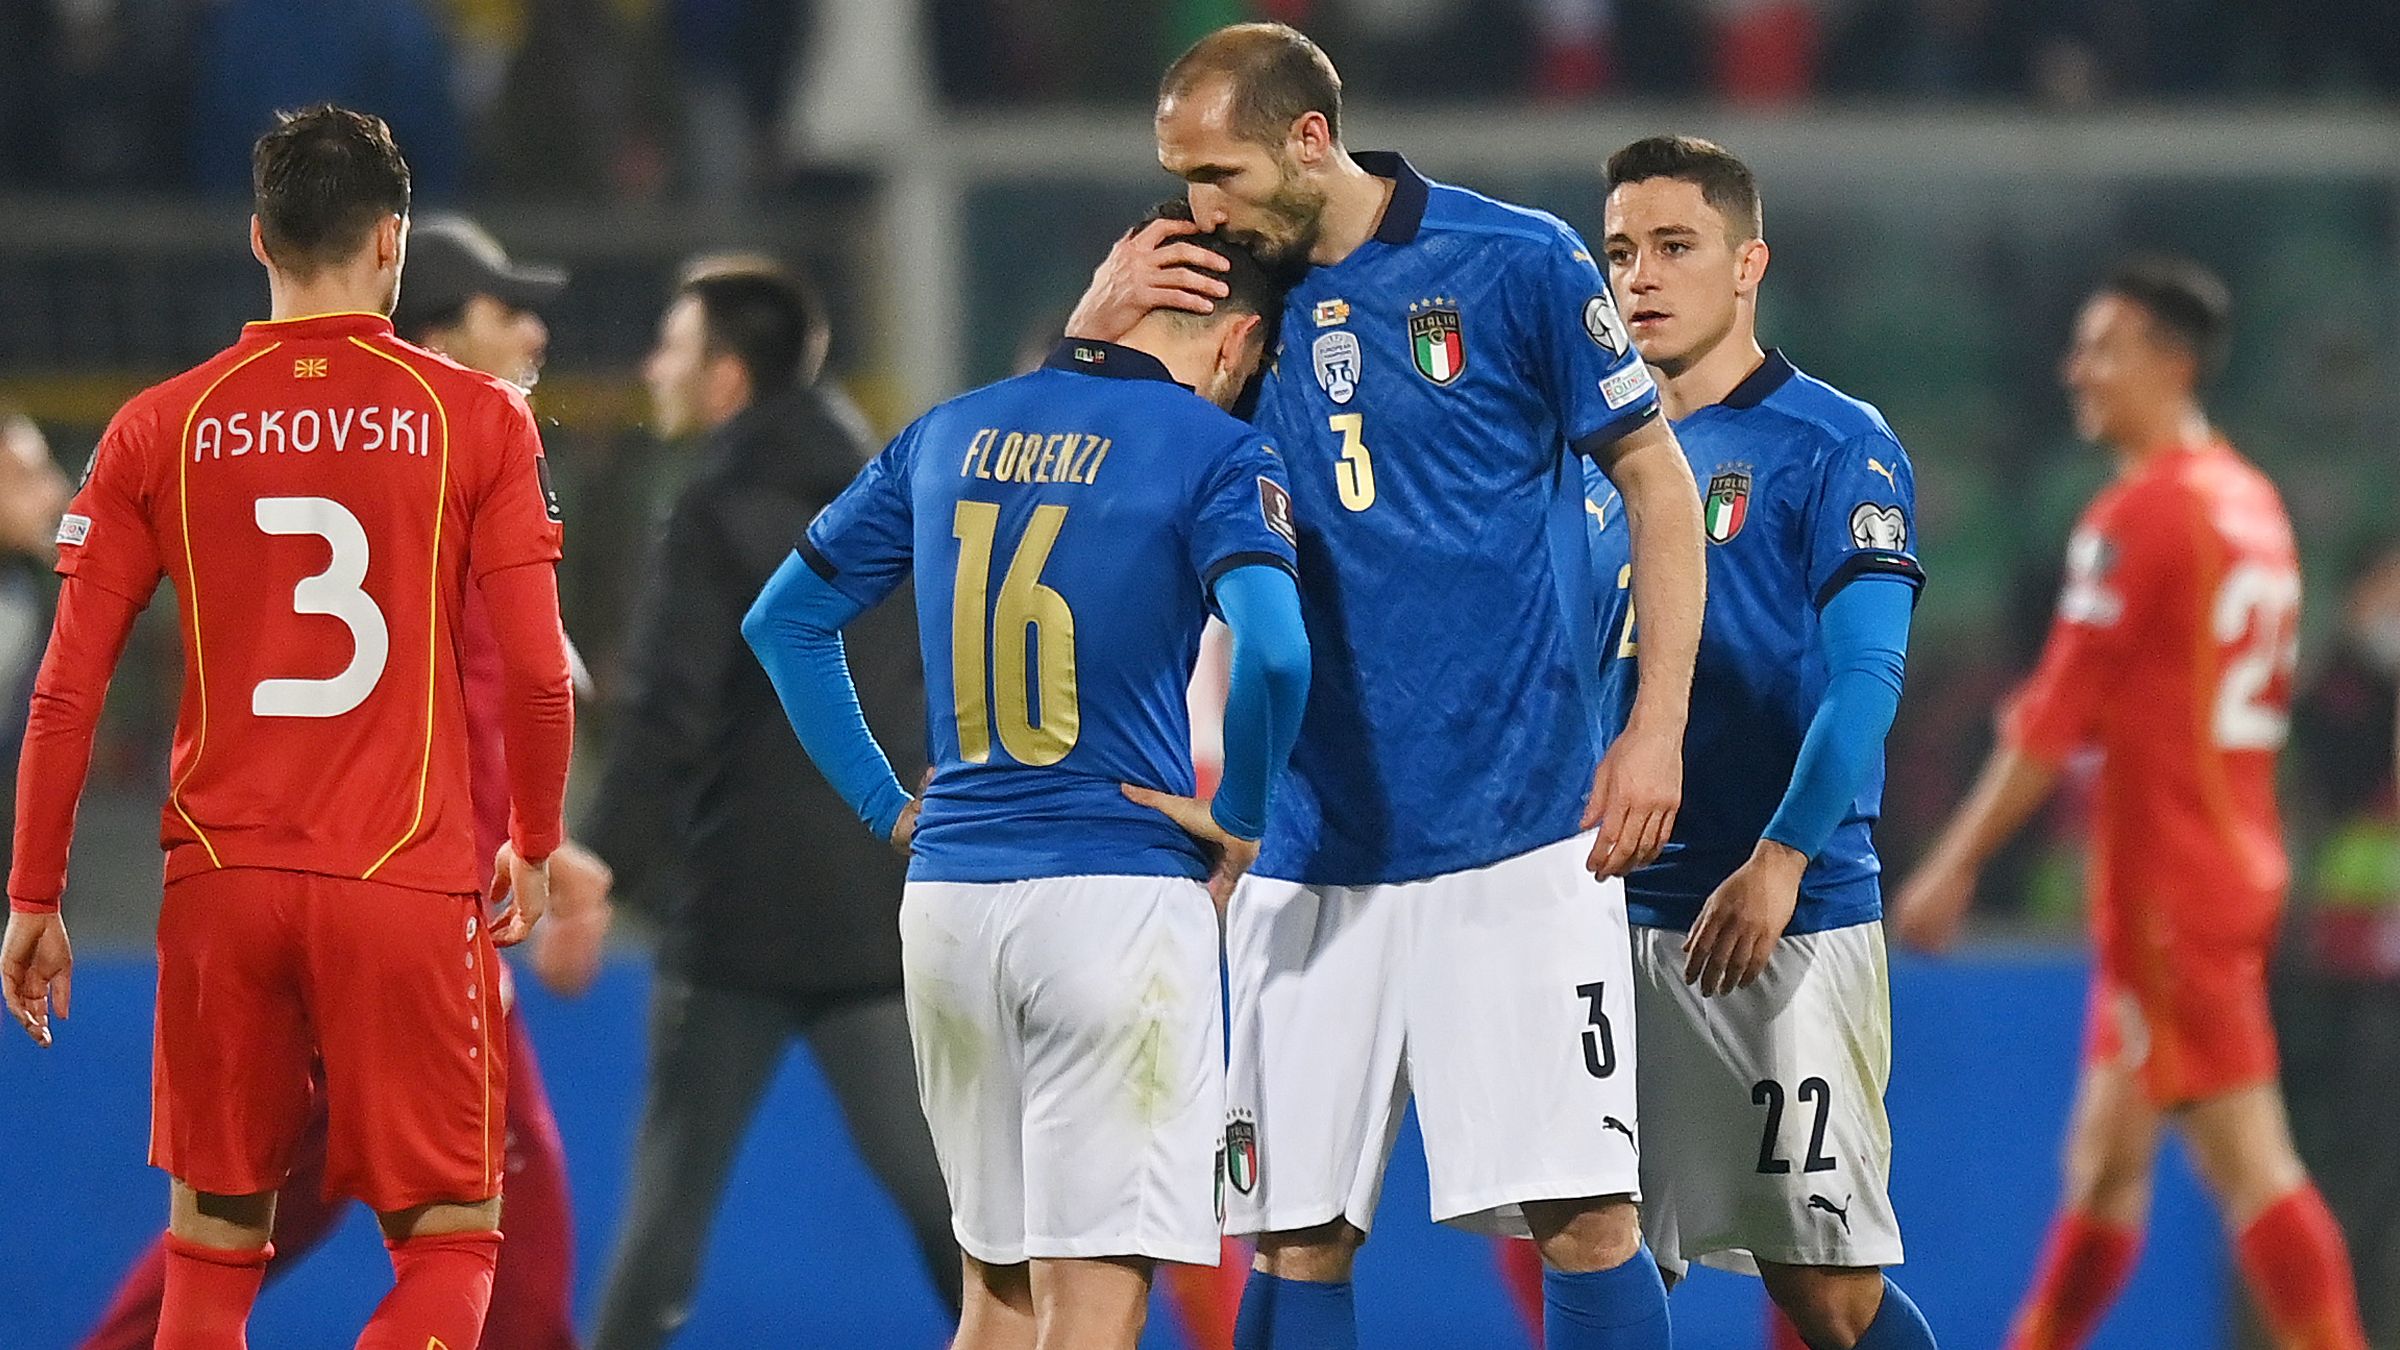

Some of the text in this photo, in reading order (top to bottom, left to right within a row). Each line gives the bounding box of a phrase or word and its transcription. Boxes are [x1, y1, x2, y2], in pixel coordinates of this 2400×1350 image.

[1413, 315, 1457, 331] ITALIA
[195, 407, 429, 462] ASKOVSKI
[961, 428, 1112, 484] FLORENZI
[1329, 413, 1375, 511] 3
[1712, 477, 1748, 491] ITALIA
[252, 497, 389, 717] 3
[952, 500, 1080, 767] 16
[1576, 981, 1616, 1079] 3
[1751, 1076, 1837, 1174] 22
